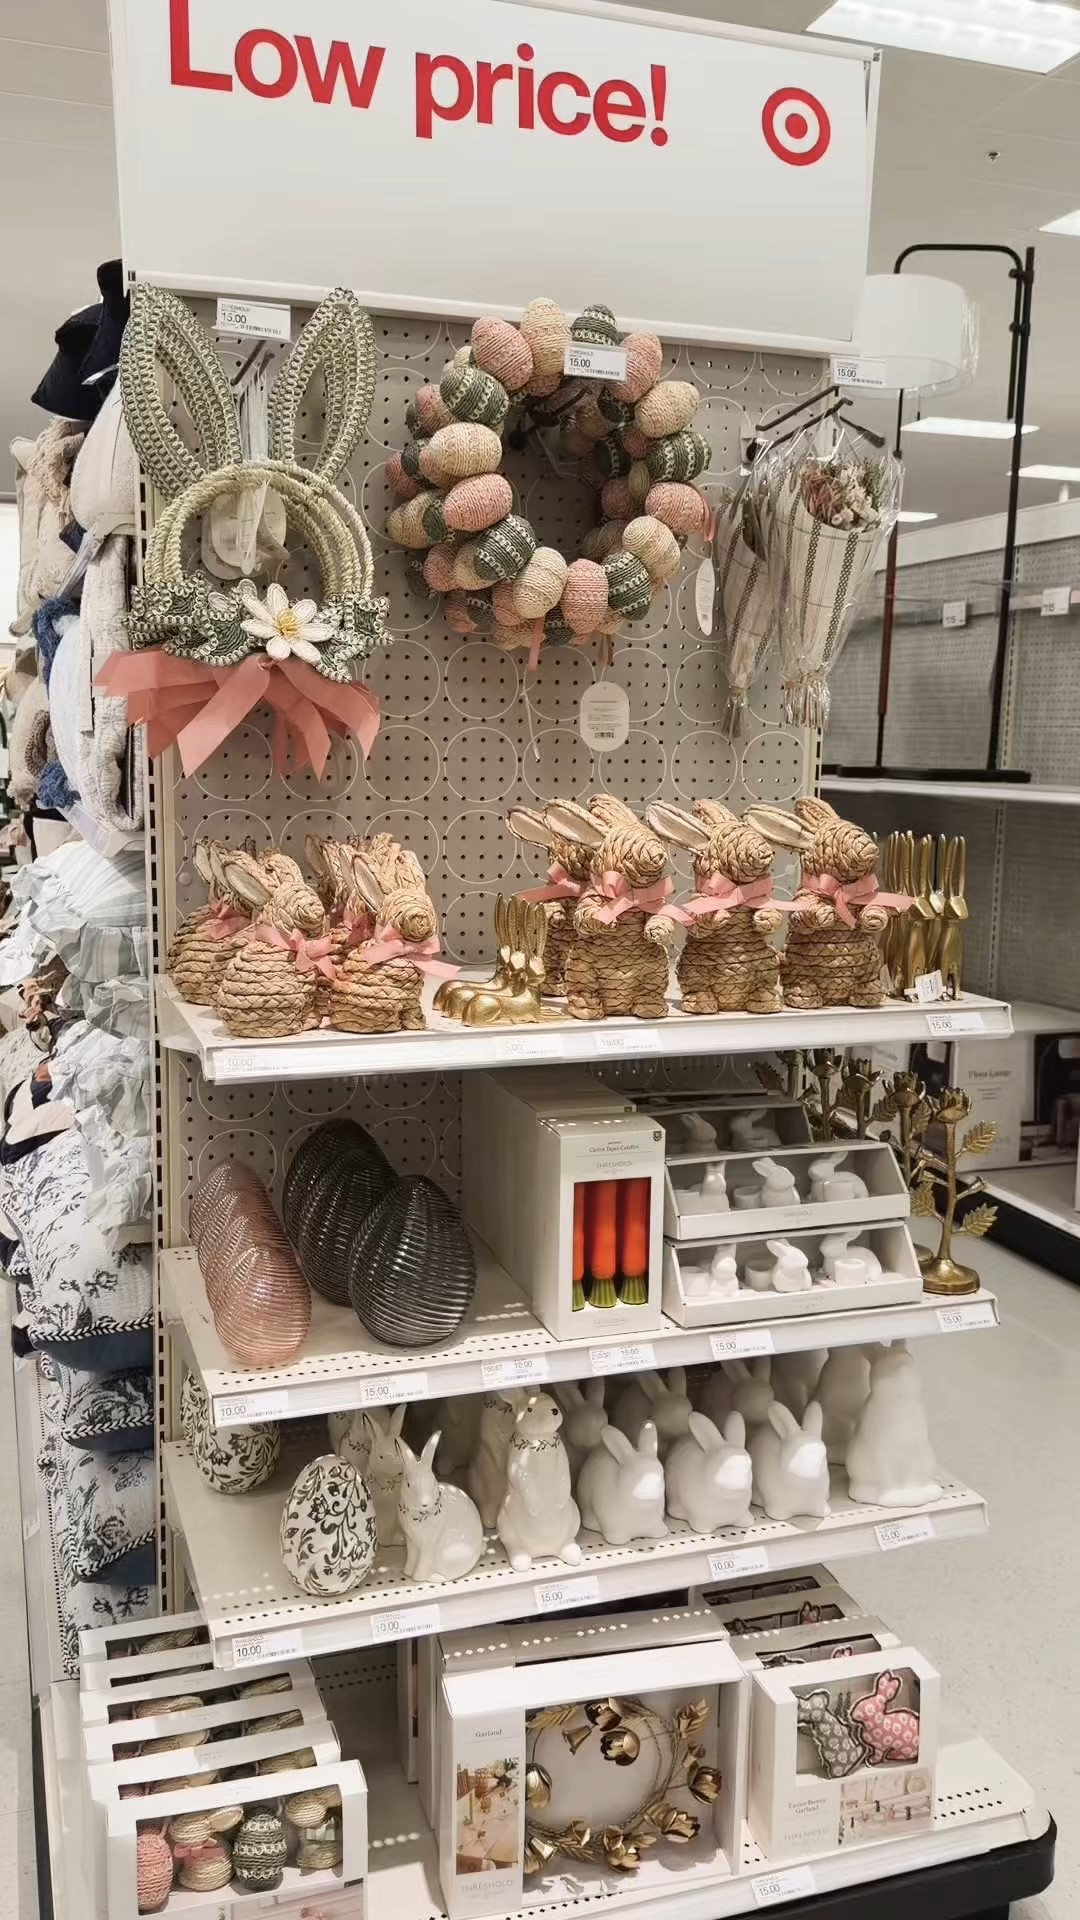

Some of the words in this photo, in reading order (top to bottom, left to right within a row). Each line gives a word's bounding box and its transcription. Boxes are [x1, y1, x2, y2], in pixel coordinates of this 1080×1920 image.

[169, 0, 385, 109] Low
[415, 43, 669, 147] price!
[222, 312, 247, 324] 15.00
[570, 357, 591, 368] 15.00
[837, 368, 857, 378] 15.00
[931, 1021, 953, 1030] 15.00
[715, 1340, 737, 1351] 15.00
[514, 1360, 533, 1369] 10.00
[364, 1386, 389, 1397] 15.00
[220, 1405, 247, 1417] 10.00
[541, 1591, 563, 1603] 15.00
[375, 1620, 400, 1633] 10.00
[236, 1644, 262, 1657] 10.00
[759, 1883, 781, 1897] 15.00
